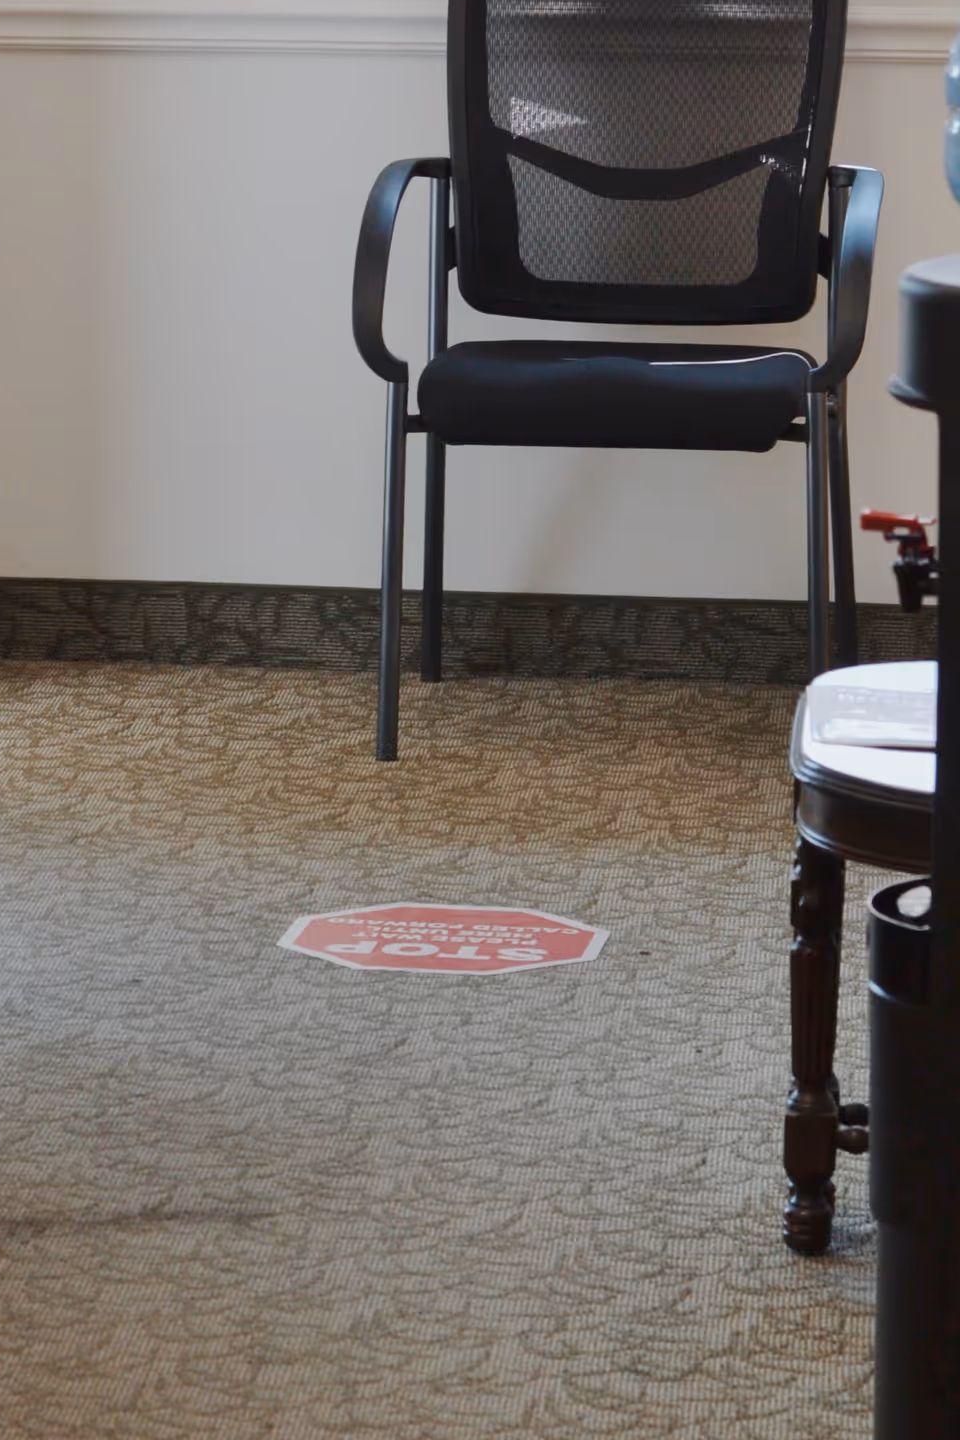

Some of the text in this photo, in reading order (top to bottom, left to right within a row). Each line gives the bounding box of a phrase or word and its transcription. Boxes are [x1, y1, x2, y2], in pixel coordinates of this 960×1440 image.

[329, 917, 580, 935] CALLED FORWARD
[367, 925, 533, 938] HERE UNTIL
[352, 931, 538, 946] PLEASE WAIT
[326, 940, 548, 961] STOP
